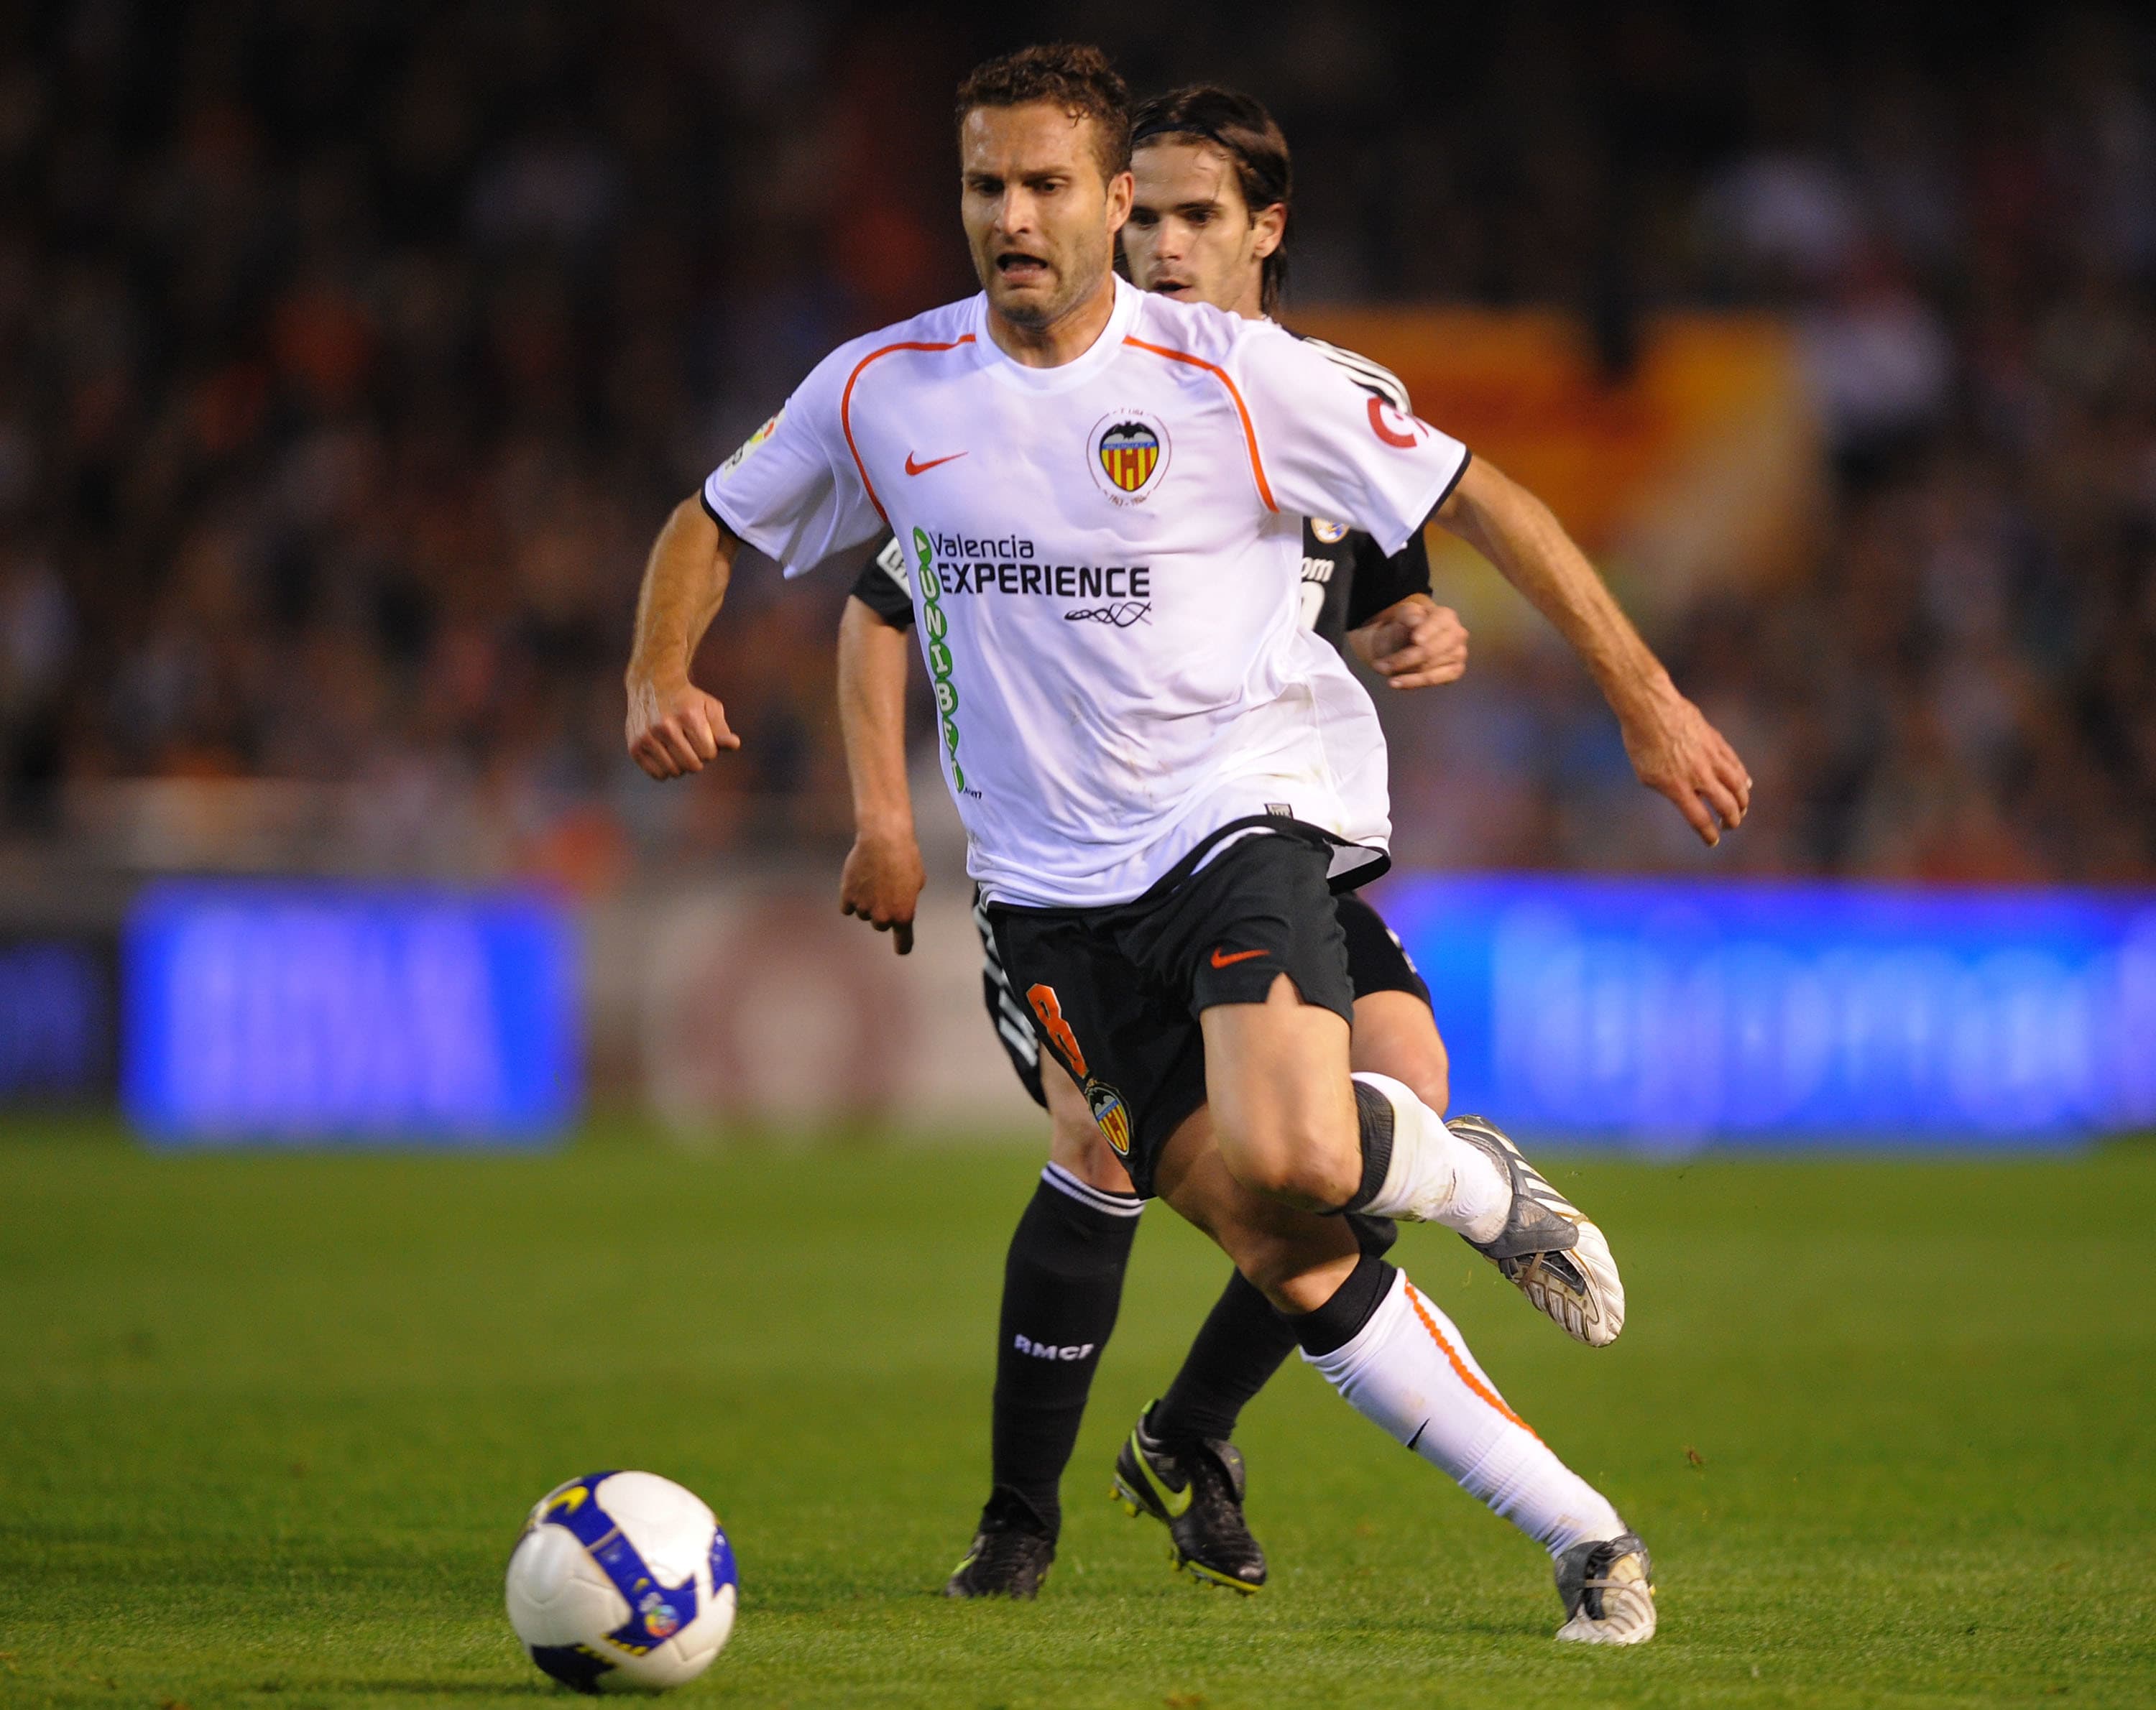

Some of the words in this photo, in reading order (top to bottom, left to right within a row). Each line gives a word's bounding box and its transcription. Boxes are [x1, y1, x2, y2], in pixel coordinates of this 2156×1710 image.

[929, 532, 1034, 558] Valencia
[937, 563, 1150, 598] EXPERIENCE
[1026, 983, 1090, 1078] 8
